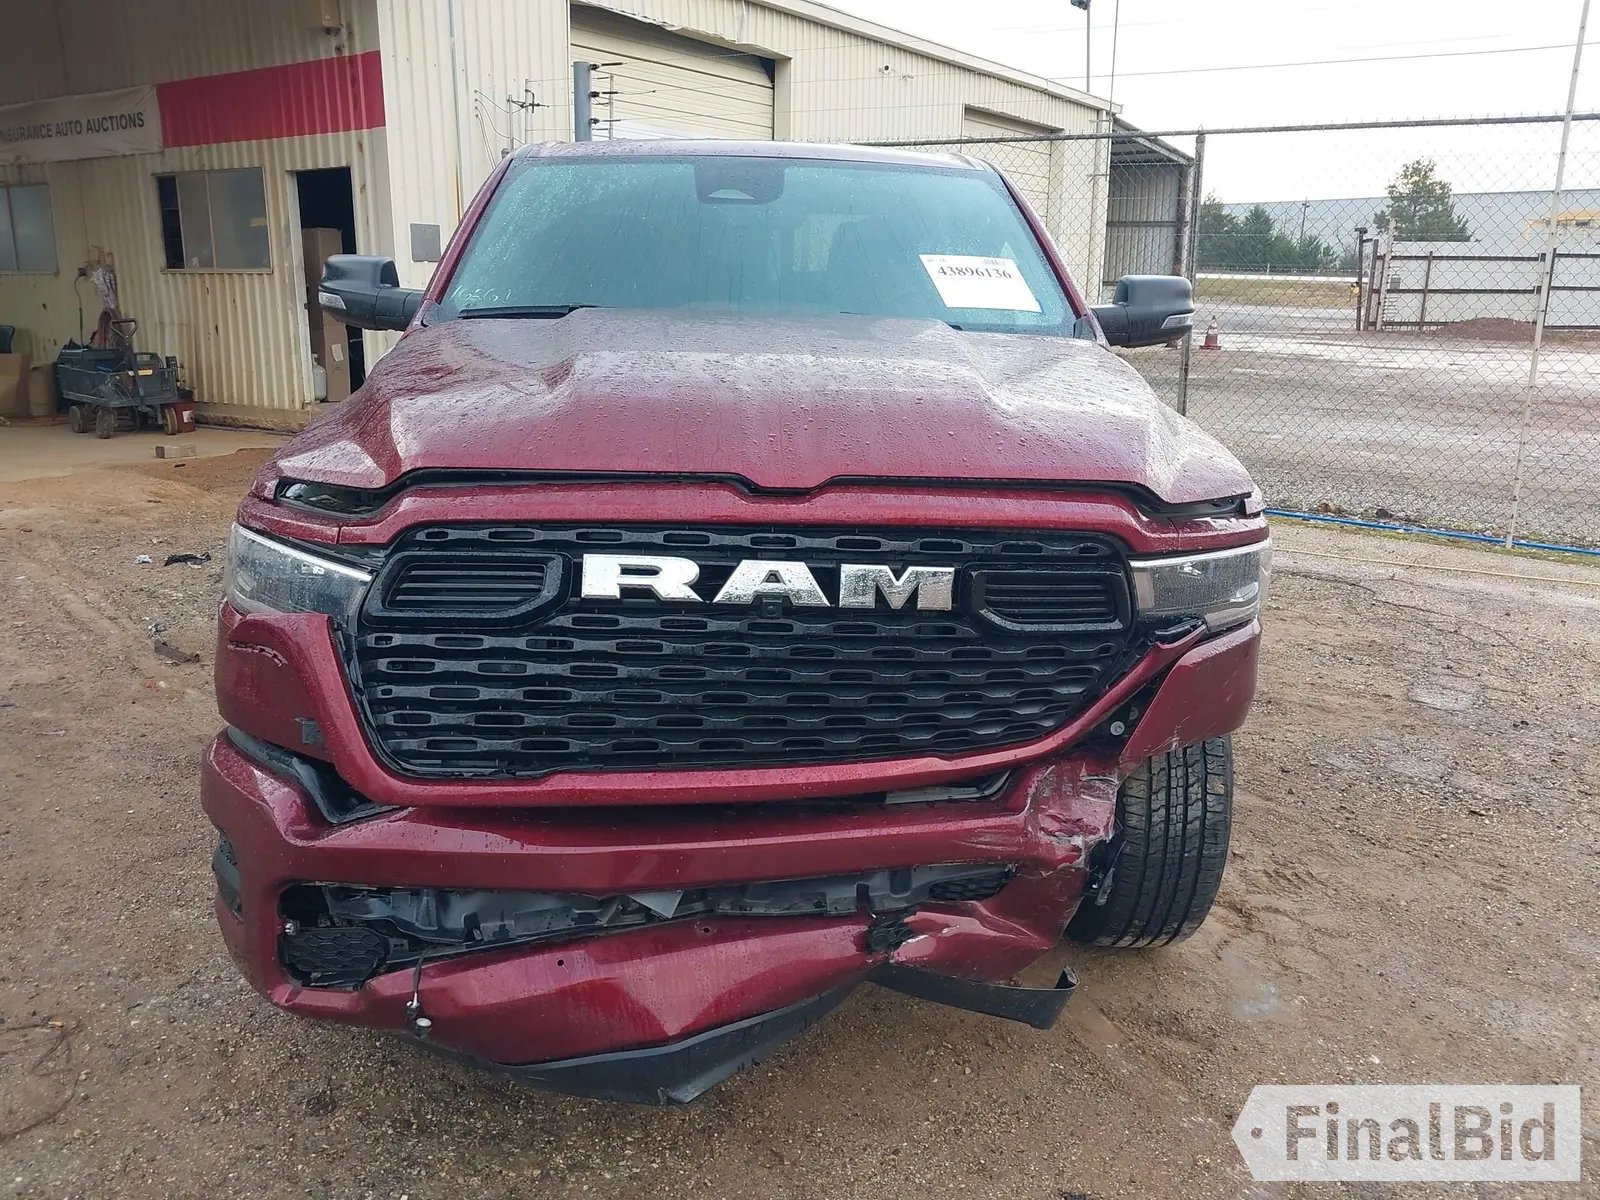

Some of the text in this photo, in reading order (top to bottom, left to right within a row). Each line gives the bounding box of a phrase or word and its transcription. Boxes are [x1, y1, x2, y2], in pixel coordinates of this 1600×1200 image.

[0, 111, 145, 144] NSURANCE AUTO AUCTIONS
[938, 265, 1012, 279] 43896136
[581, 553, 955, 611] RAM
